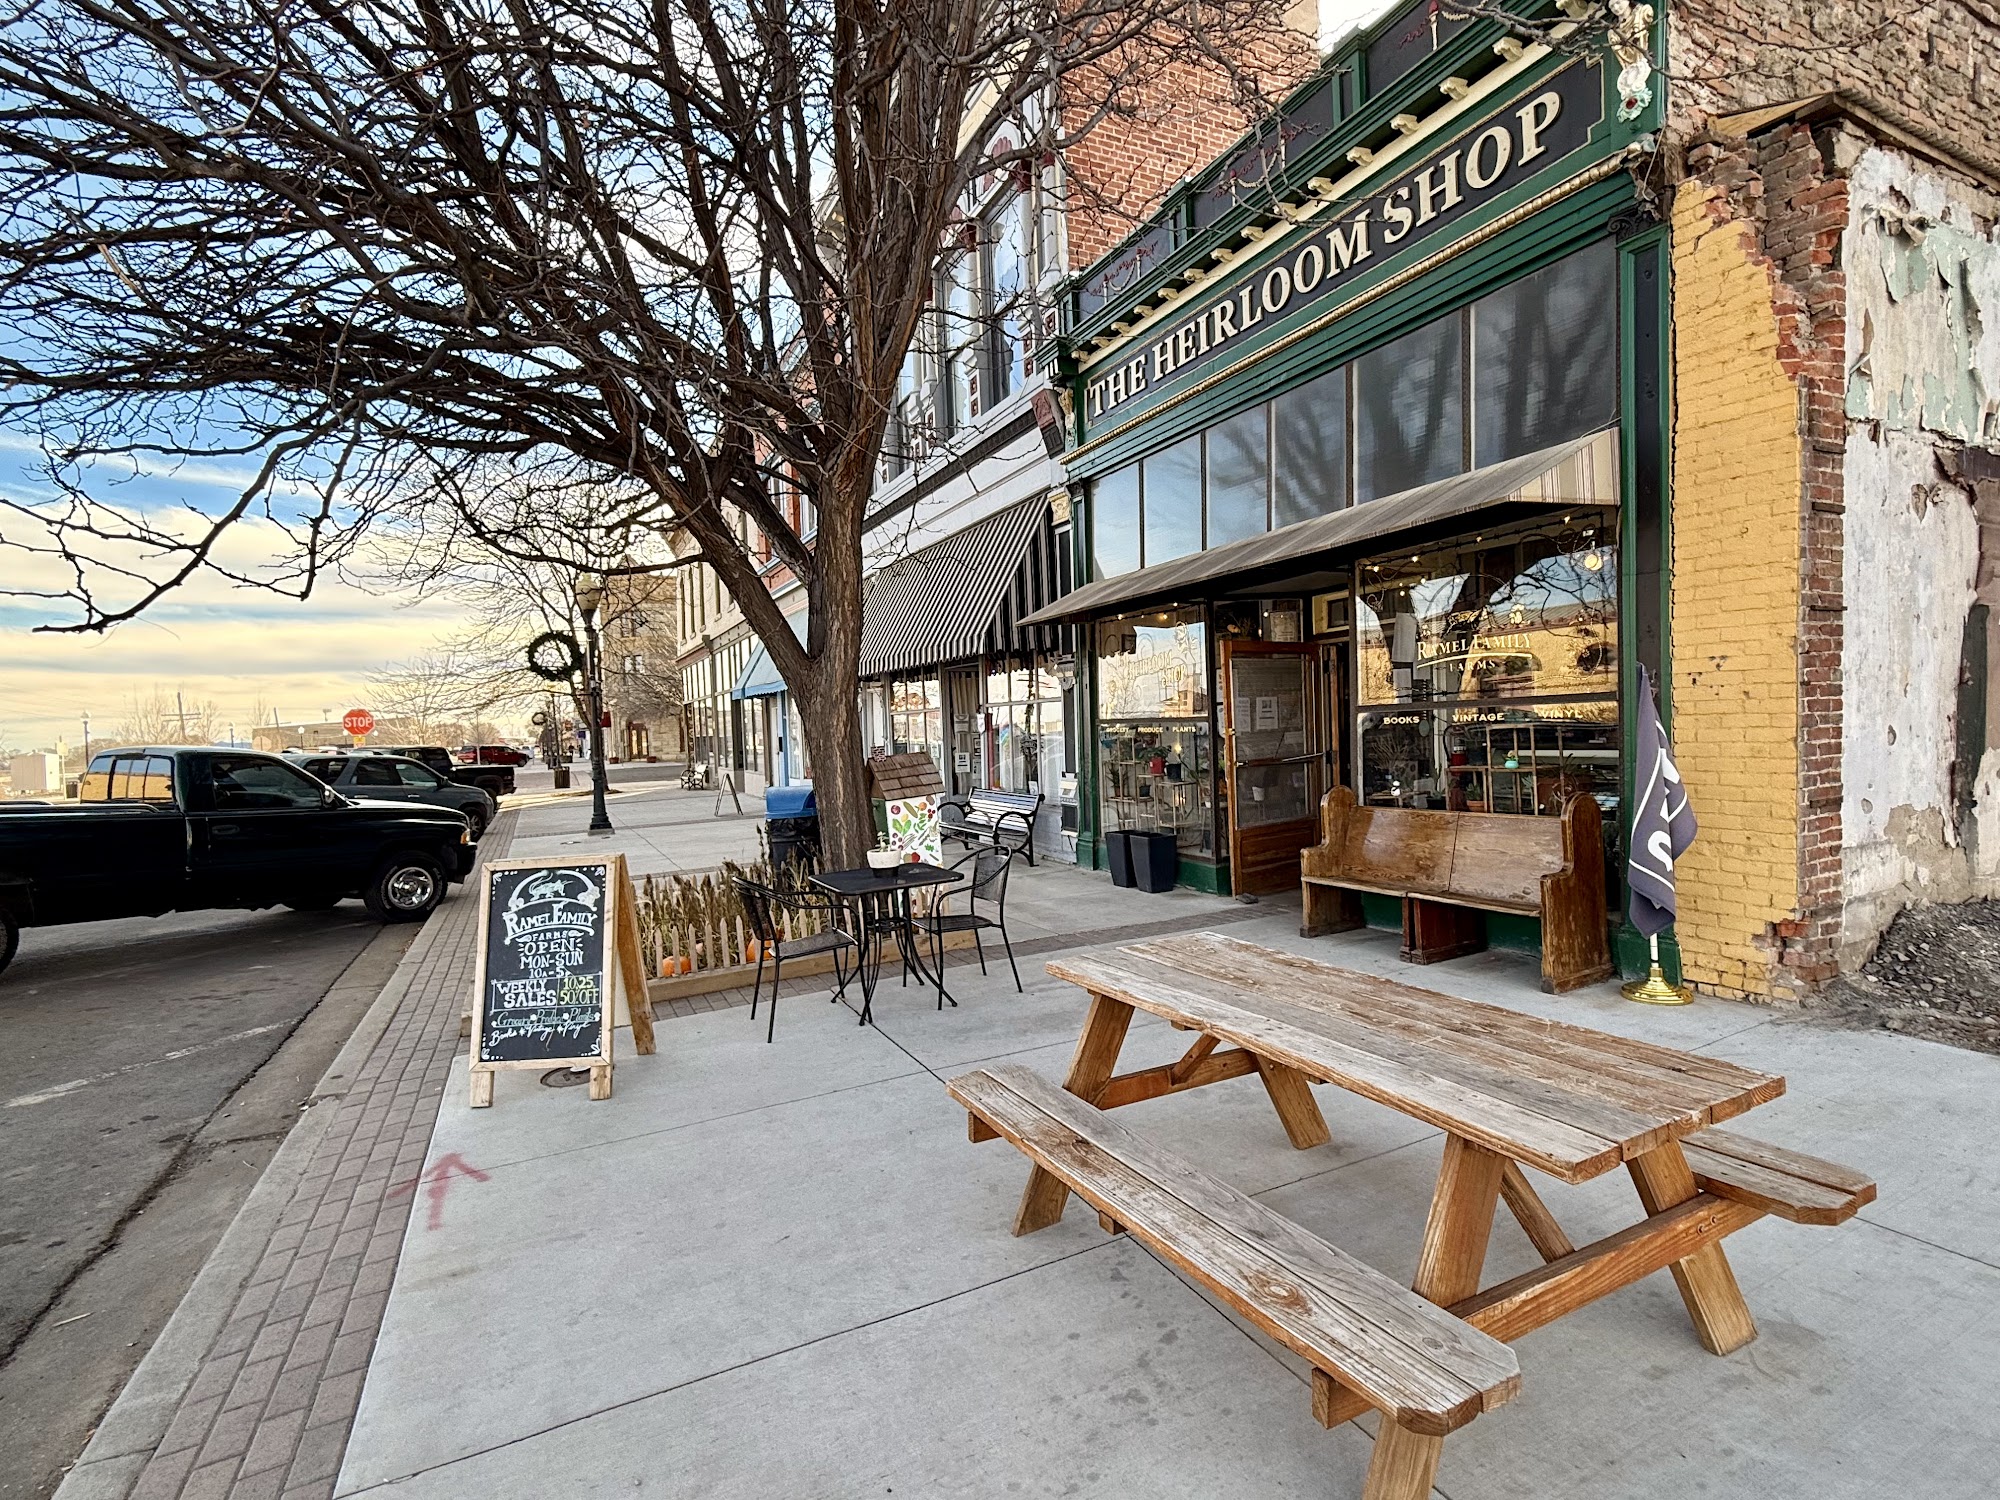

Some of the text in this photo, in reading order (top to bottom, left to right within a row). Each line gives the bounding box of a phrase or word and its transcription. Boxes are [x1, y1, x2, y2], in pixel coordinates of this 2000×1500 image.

[1090, 91, 1561, 418] THE HEIRLOOM SHOP
[1417, 632, 1532, 661] RAMEL FAMILY
[344, 716, 373, 728] STOP
[1383, 715, 1420, 725] BOOKS
[1452, 712, 1505, 723] VINTAGE
[1542, 709, 1583, 719] VINYL
[552, 902, 598, 926] FAMILY
[532, 930, 568, 942] FARMS
[524, 937, 576, 956] OPEN
[520, 951, 584, 969] MON-SUN
[496, 979, 547, 994] WEEKLY
[503, 990, 557, 1008] SALES
